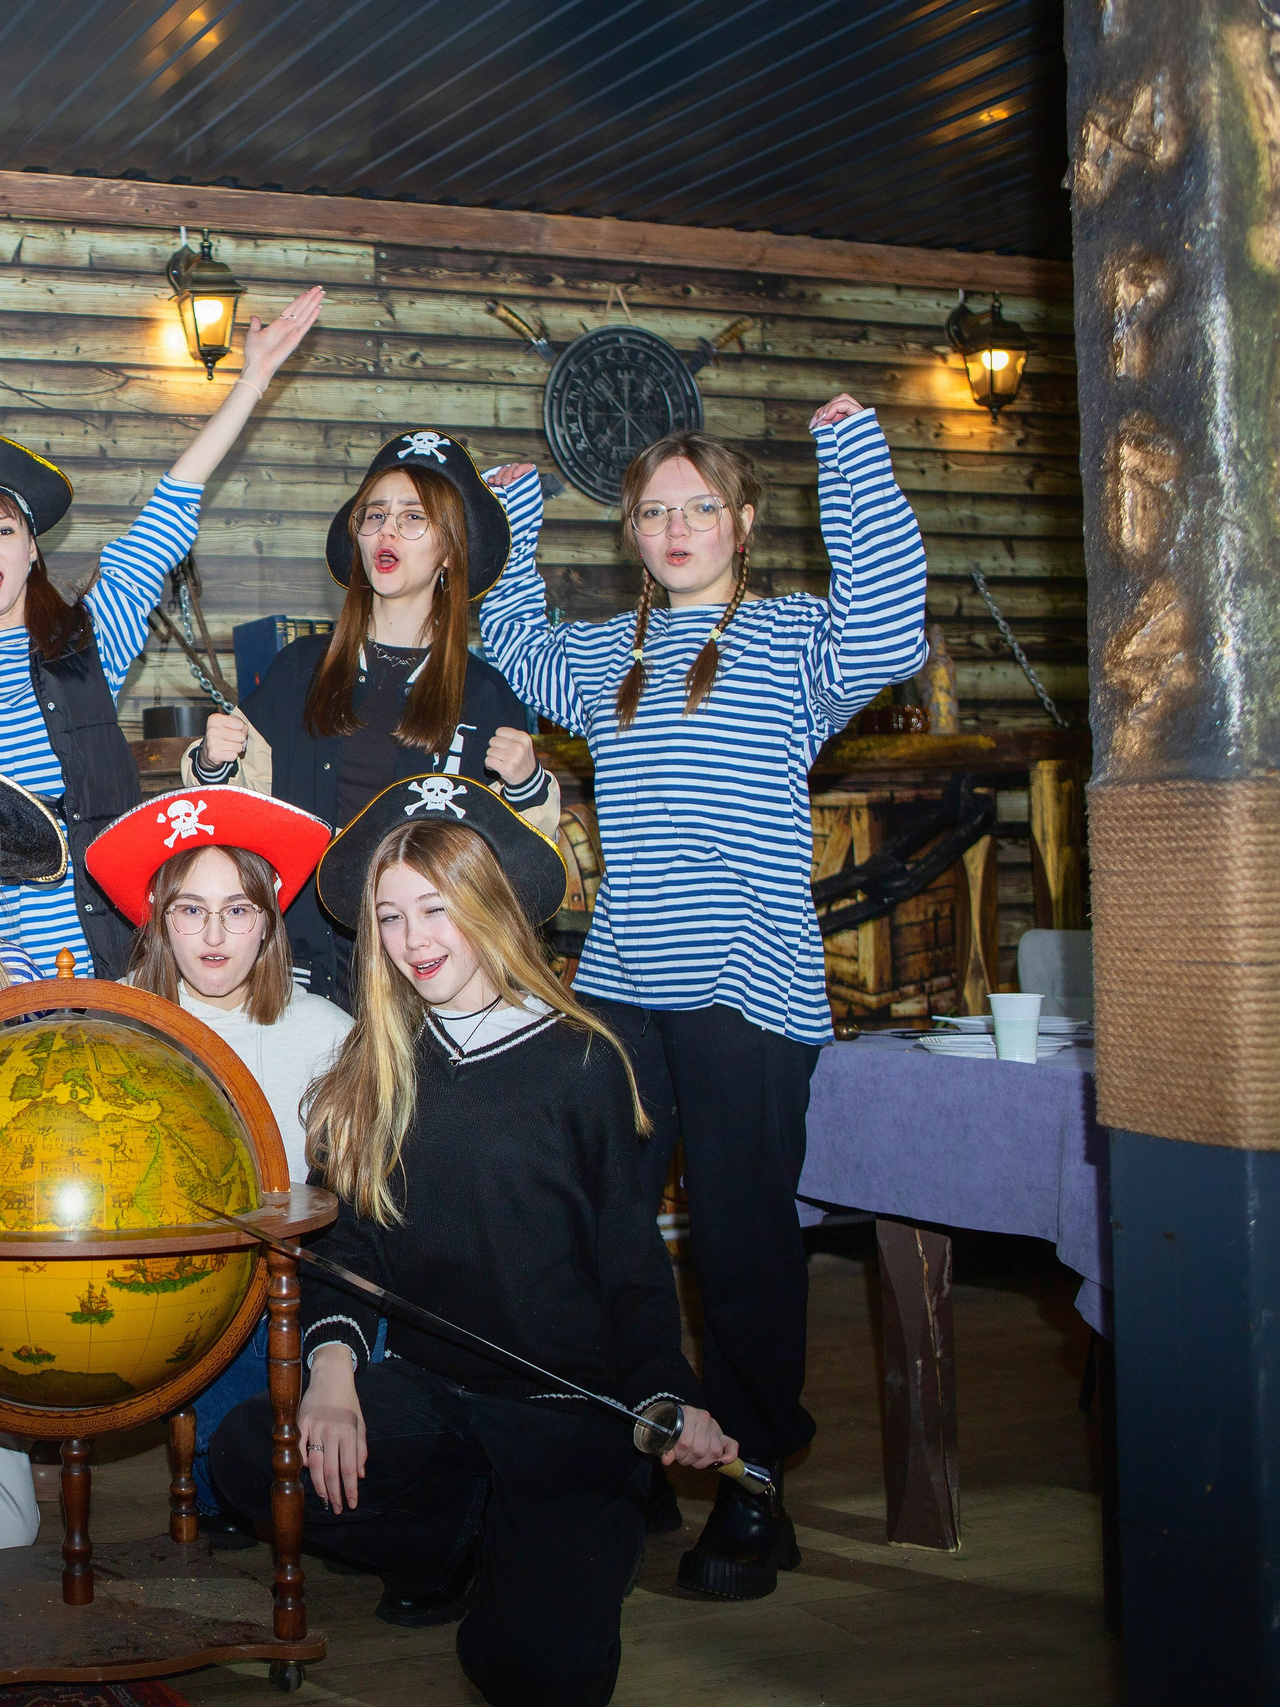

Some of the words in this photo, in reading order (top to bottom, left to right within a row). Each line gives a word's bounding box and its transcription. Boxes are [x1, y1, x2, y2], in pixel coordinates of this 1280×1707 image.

[21, 988, 54, 1001] FRIGIDA
[55, 987, 127, 1002] SEPTENTRIONALIS
[208, 1325, 240, 1363] TEMPERATA
[71, 1411, 128, 1429] MERIDIONALIS
